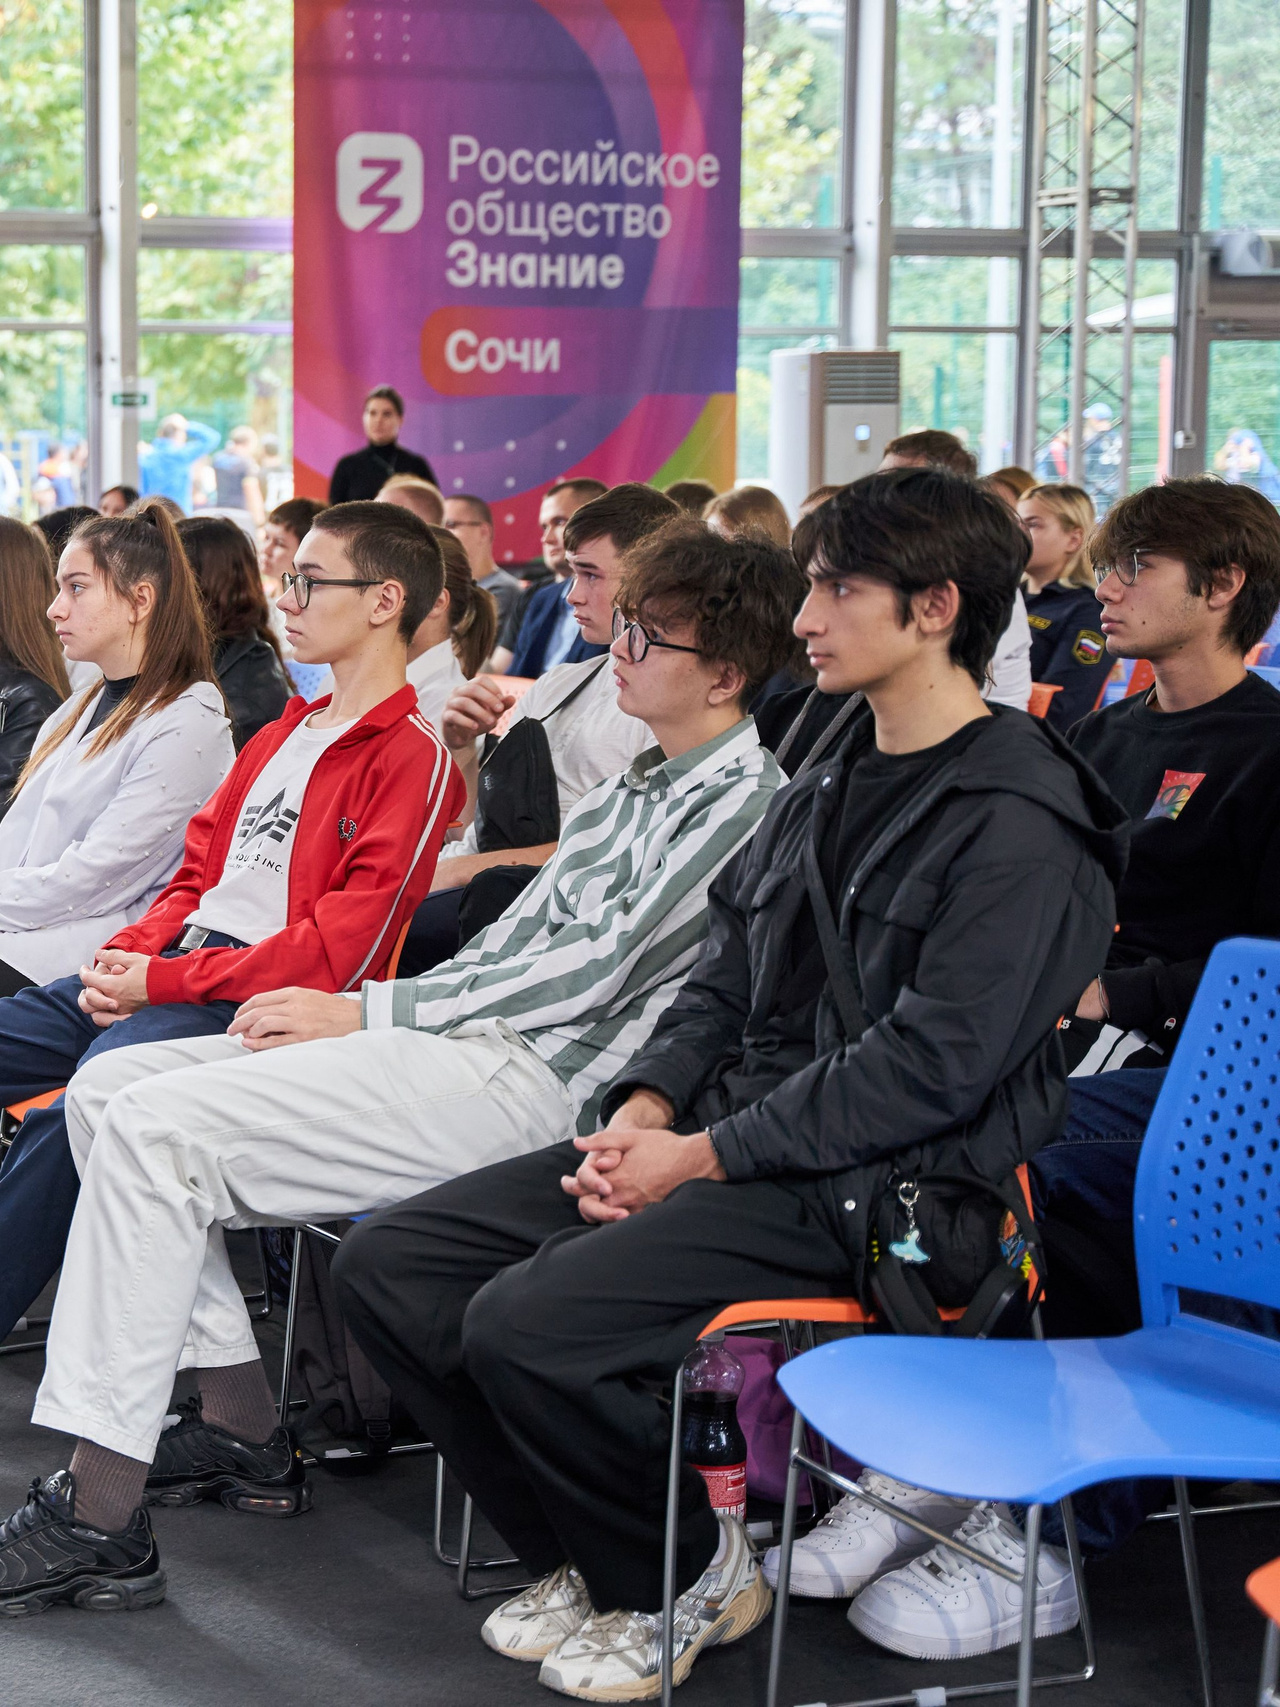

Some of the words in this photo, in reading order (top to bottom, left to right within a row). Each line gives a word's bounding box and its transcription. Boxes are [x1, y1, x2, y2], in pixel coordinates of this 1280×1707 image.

[448, 134, 720, 188] Российское
[445, 187, 672, 244] общество
[445, 239, 625, 289] Знание
[445, 328, 561, 374] Сочи
